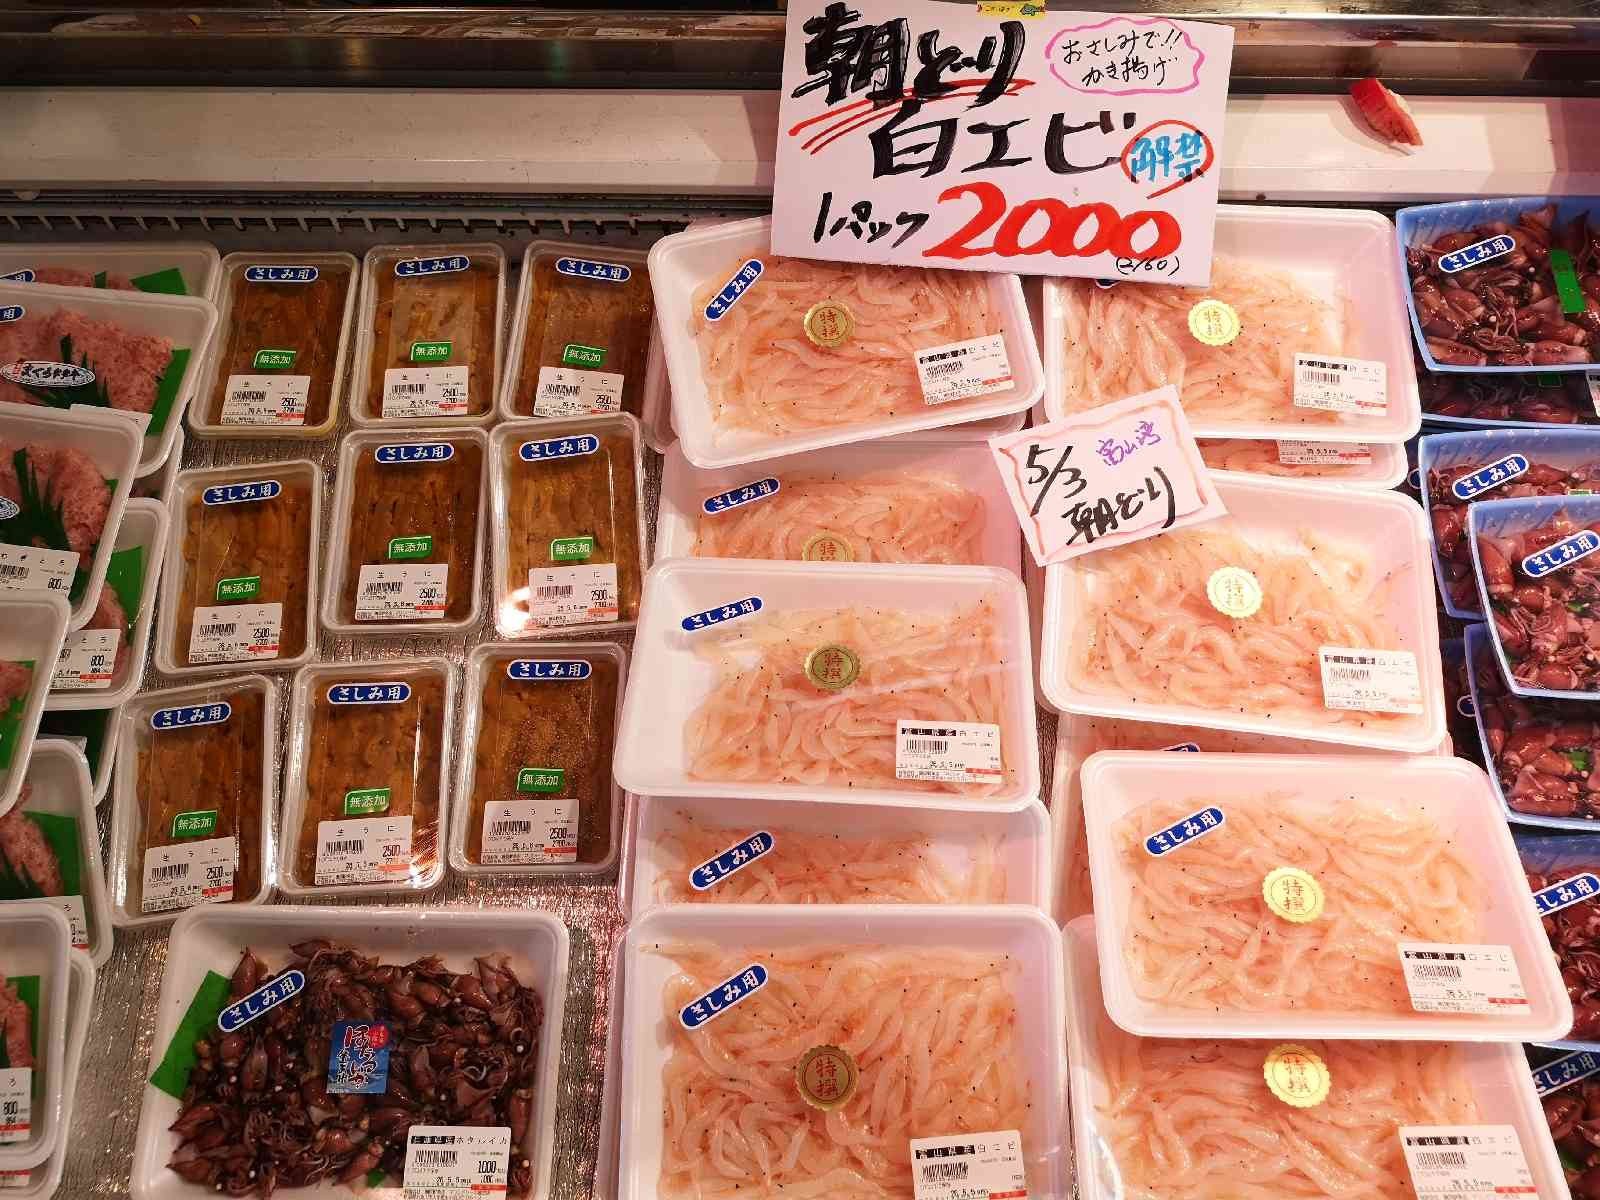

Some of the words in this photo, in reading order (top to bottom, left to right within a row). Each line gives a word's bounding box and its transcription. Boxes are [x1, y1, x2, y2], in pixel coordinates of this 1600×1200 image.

[791, 2, 1026, 111] 朝どり
[1082, 57, 1179, 87] かき揚げ
[869, 100, 1136, 178] 白エビ
[1131, 132, 1204, 182] 解禁
[814, 192, 929, 248] 1パック
[922, 181, 1181, 259] 2000
[1448, 239, 1506, 269] さしみ用
[254, 267, 310, 280] さしみ用
[405, 257, 461, 274] さしみ用
[566, 261, 621, 279] さしみ用
[711, 265, 758, 315] さしみ用
[260, 353, 292, 365] 無添加
[415, 346, 448, 357] 無添加
[568, 349, 601, 361] 無添加
[386, 445, 444, 460] さしみ用
[530, 437, 590, 458] さしみ用
[1026, 443, 1087, 518] 5/3
[1462, 459, 1521, 494] さしみ用
[213, 484, 272, 501] さしみ用
[713, 482, 770, 508] さしみ用
[1061, 466, 1176, 546] 朝どり
[393, 542, 428, 553] 無添加
[555, 544, 589, 555] 無添加
[1533, 537, 1593, 572] さしみ用
[221, 582, 256, 594] 無添加
[691, 599, 754, 627] さしみ用
[519, 662, 581, 677] さしみ用
[338, 685, 400, 700] さしみ用
[163, 706, 221, 726] さしみ用
[523, 774, 558, 786] 無添加
[350, 796, 386, 808] 無添加
[178, 816, 212, 830] 無添加
[549, 827, 568, 840] 2500
[1154, 810, 1217, 851] さしみ用
[702, 840, 765, 882] さしみ用
[1282, 877, 1306, 911] 特撰
[230, 979, 296, 1023] さしみ用
[692, 971, 759, 1021] さしみ用
[815, 1056, 839, 1098] 特撰
[477, 1160, 497, 1174] 1000
